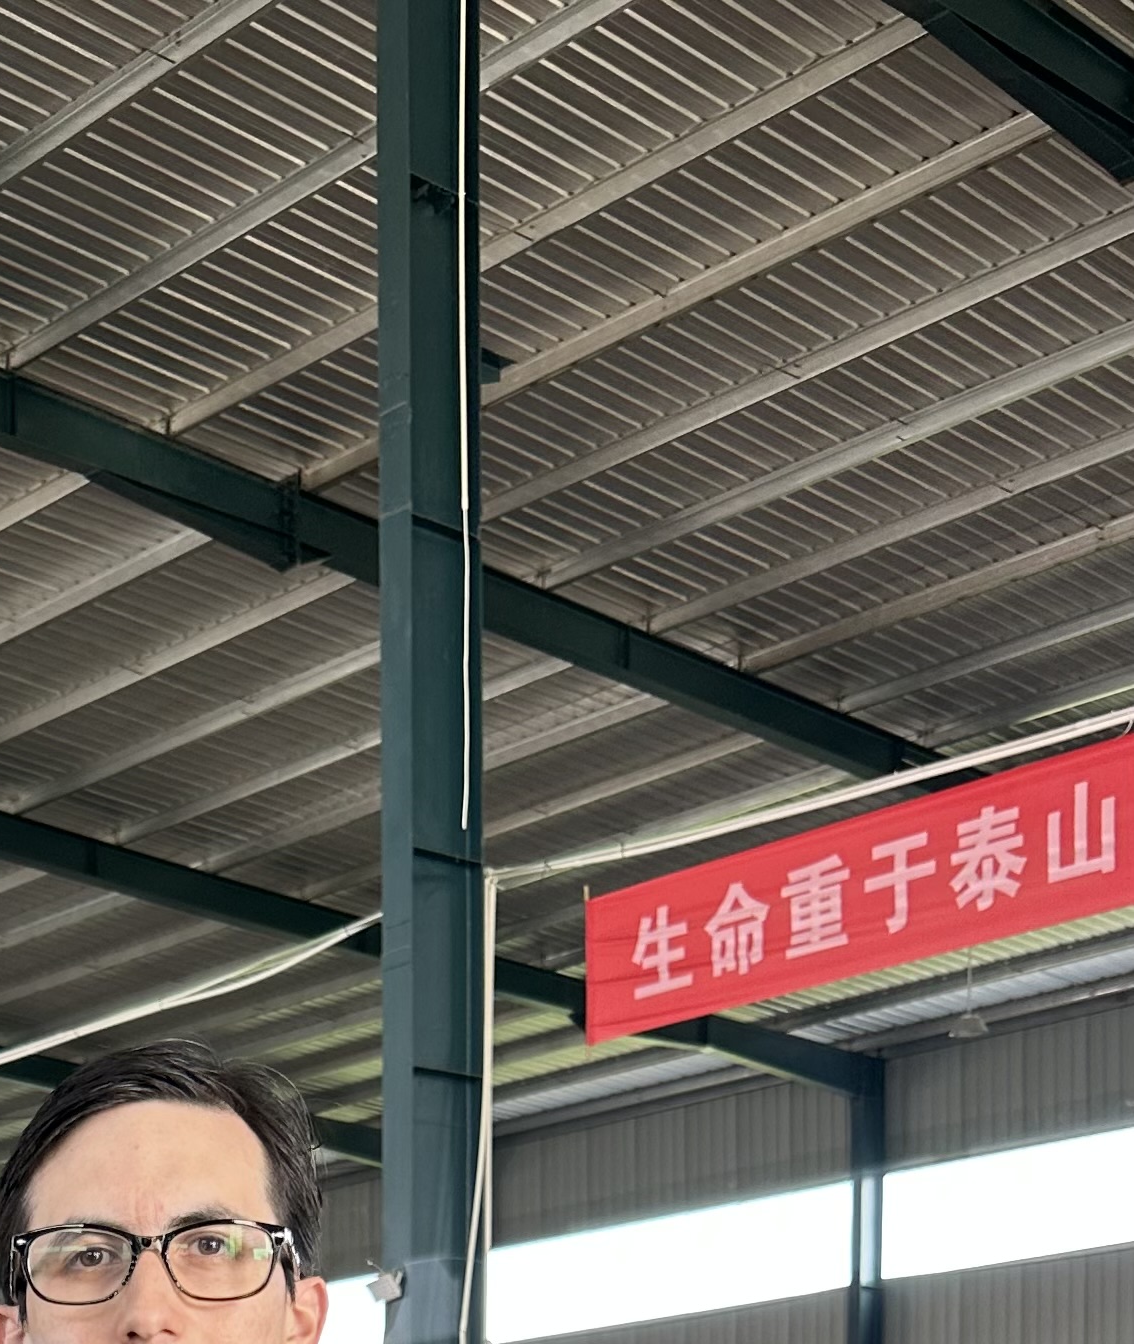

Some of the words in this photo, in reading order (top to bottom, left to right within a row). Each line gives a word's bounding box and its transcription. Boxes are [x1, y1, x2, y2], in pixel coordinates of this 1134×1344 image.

[631, 782, 1116, 1000] 生命重于泰山
